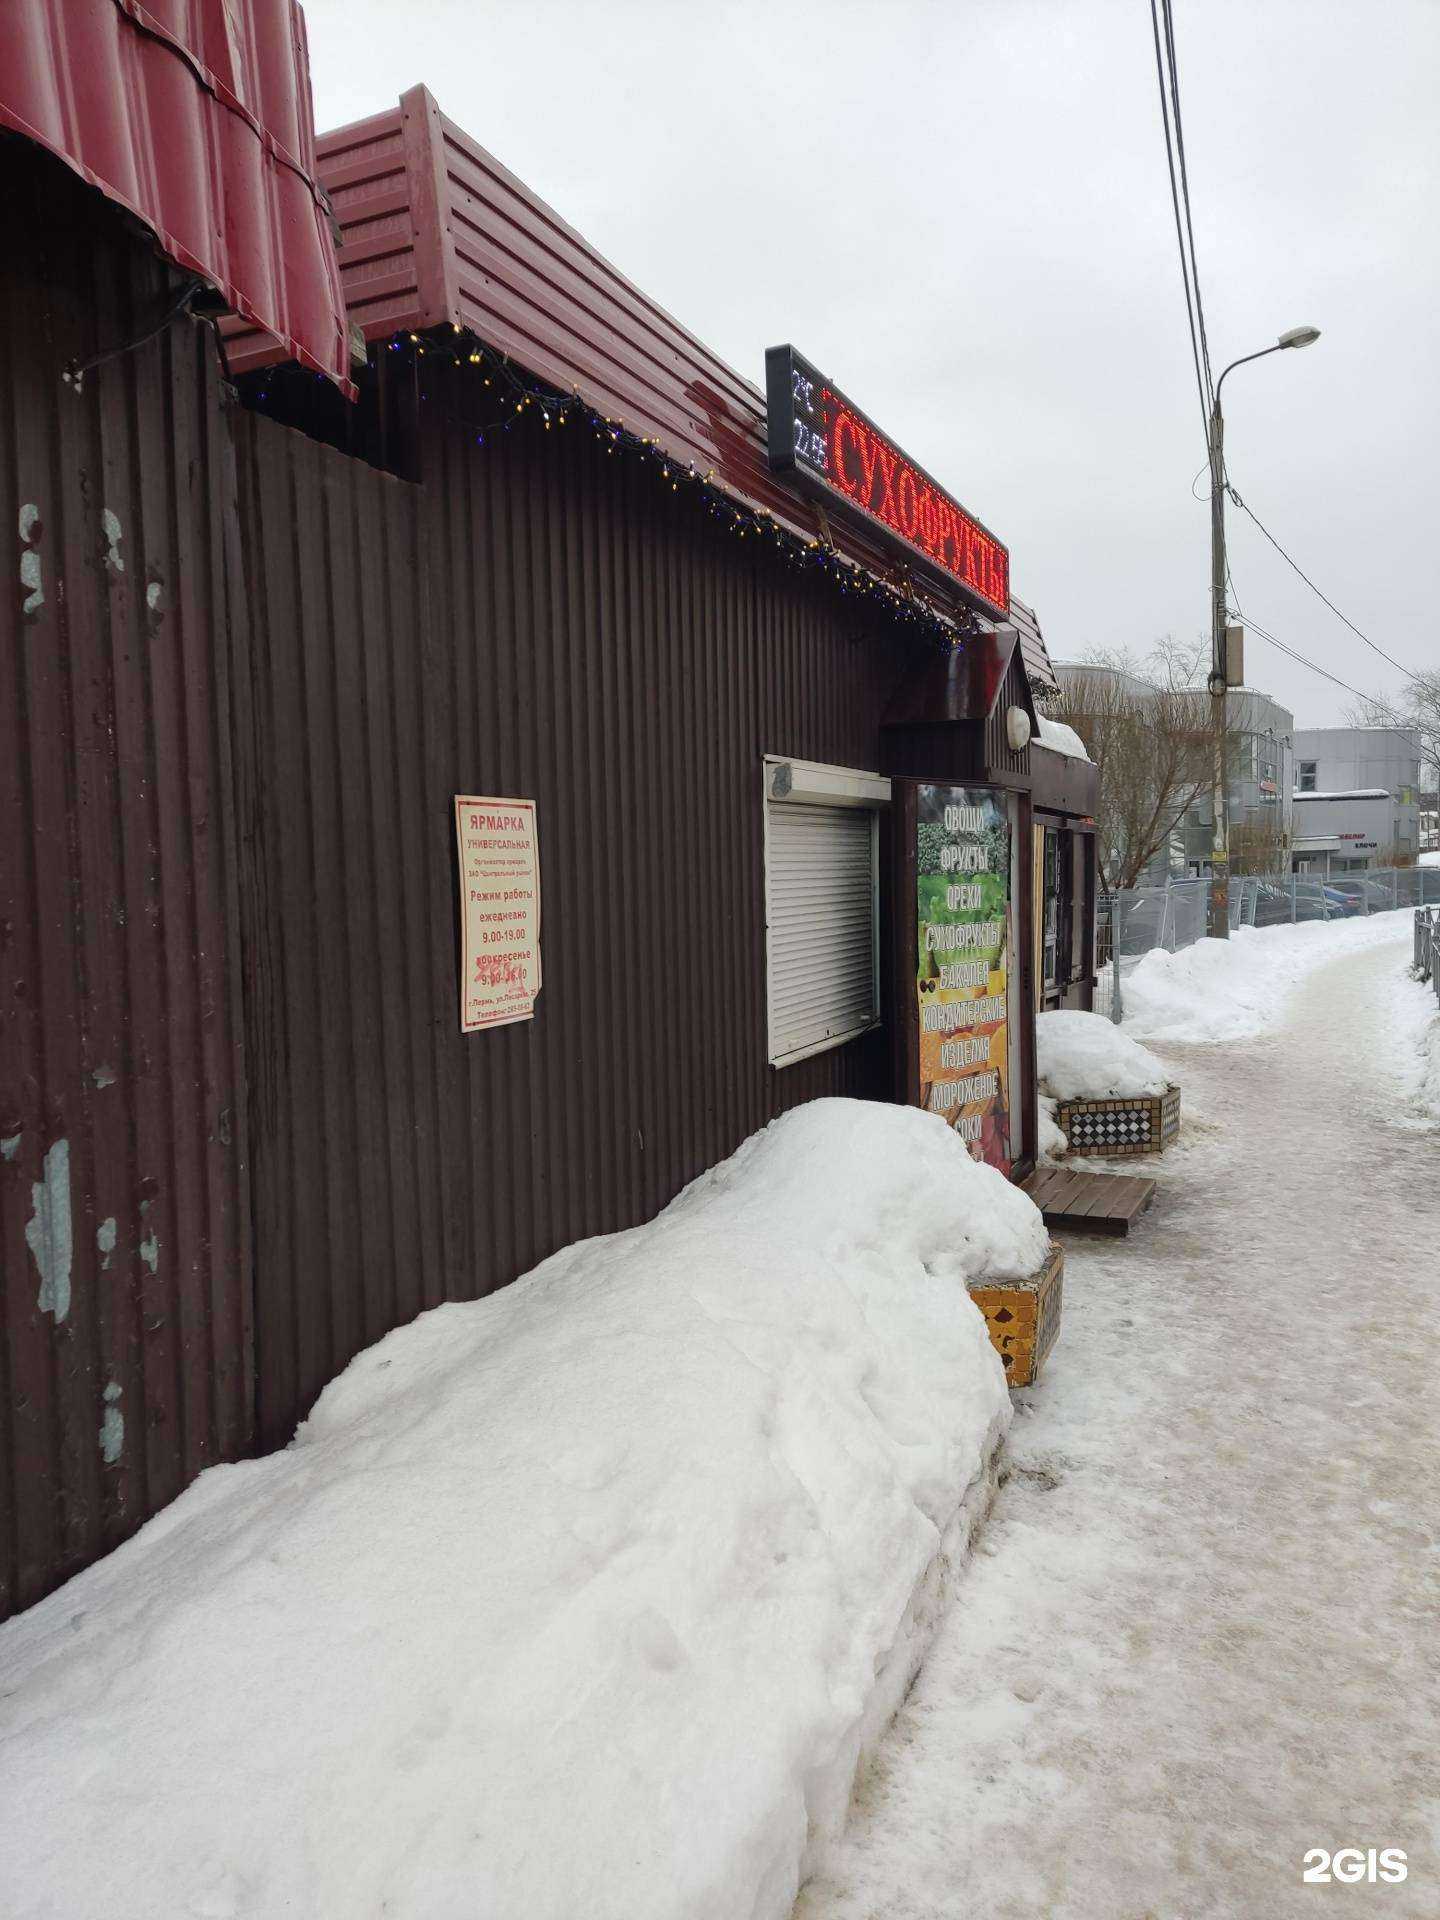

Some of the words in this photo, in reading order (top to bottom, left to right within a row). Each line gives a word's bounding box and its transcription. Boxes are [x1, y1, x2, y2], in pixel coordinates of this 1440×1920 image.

[832, 409, 1006, 606] СУХОФРУКТЫ
[470, 814, 525, 831] ЯРМАРКА
[944, 805, 984, 831] ОВОЩИ
[467, 839, 530, 850] УНИВЕРСАЛЬНАЯ
[941, 845, 989, 871] ФРУКТЫ
[470, 890, 501, 901] Режим
[503, 888, 533, 903] работы
[947, 884, 982, 911] ОРЕХИ
[479, 911, 527, 923] ежедневно
[926, 923, 1001, 952] СУХОФРУКТЫ
[940, 960, 990, 990] БАКАЛЕЯ
[923, 996, 1006, 1033] КОНДИТЕРСКИЕ
[941, 1036, 990, 1069] ИЗДЕЛИЯ
[932, 1072, 999, 1111] МОРОЖЕНОЕ
